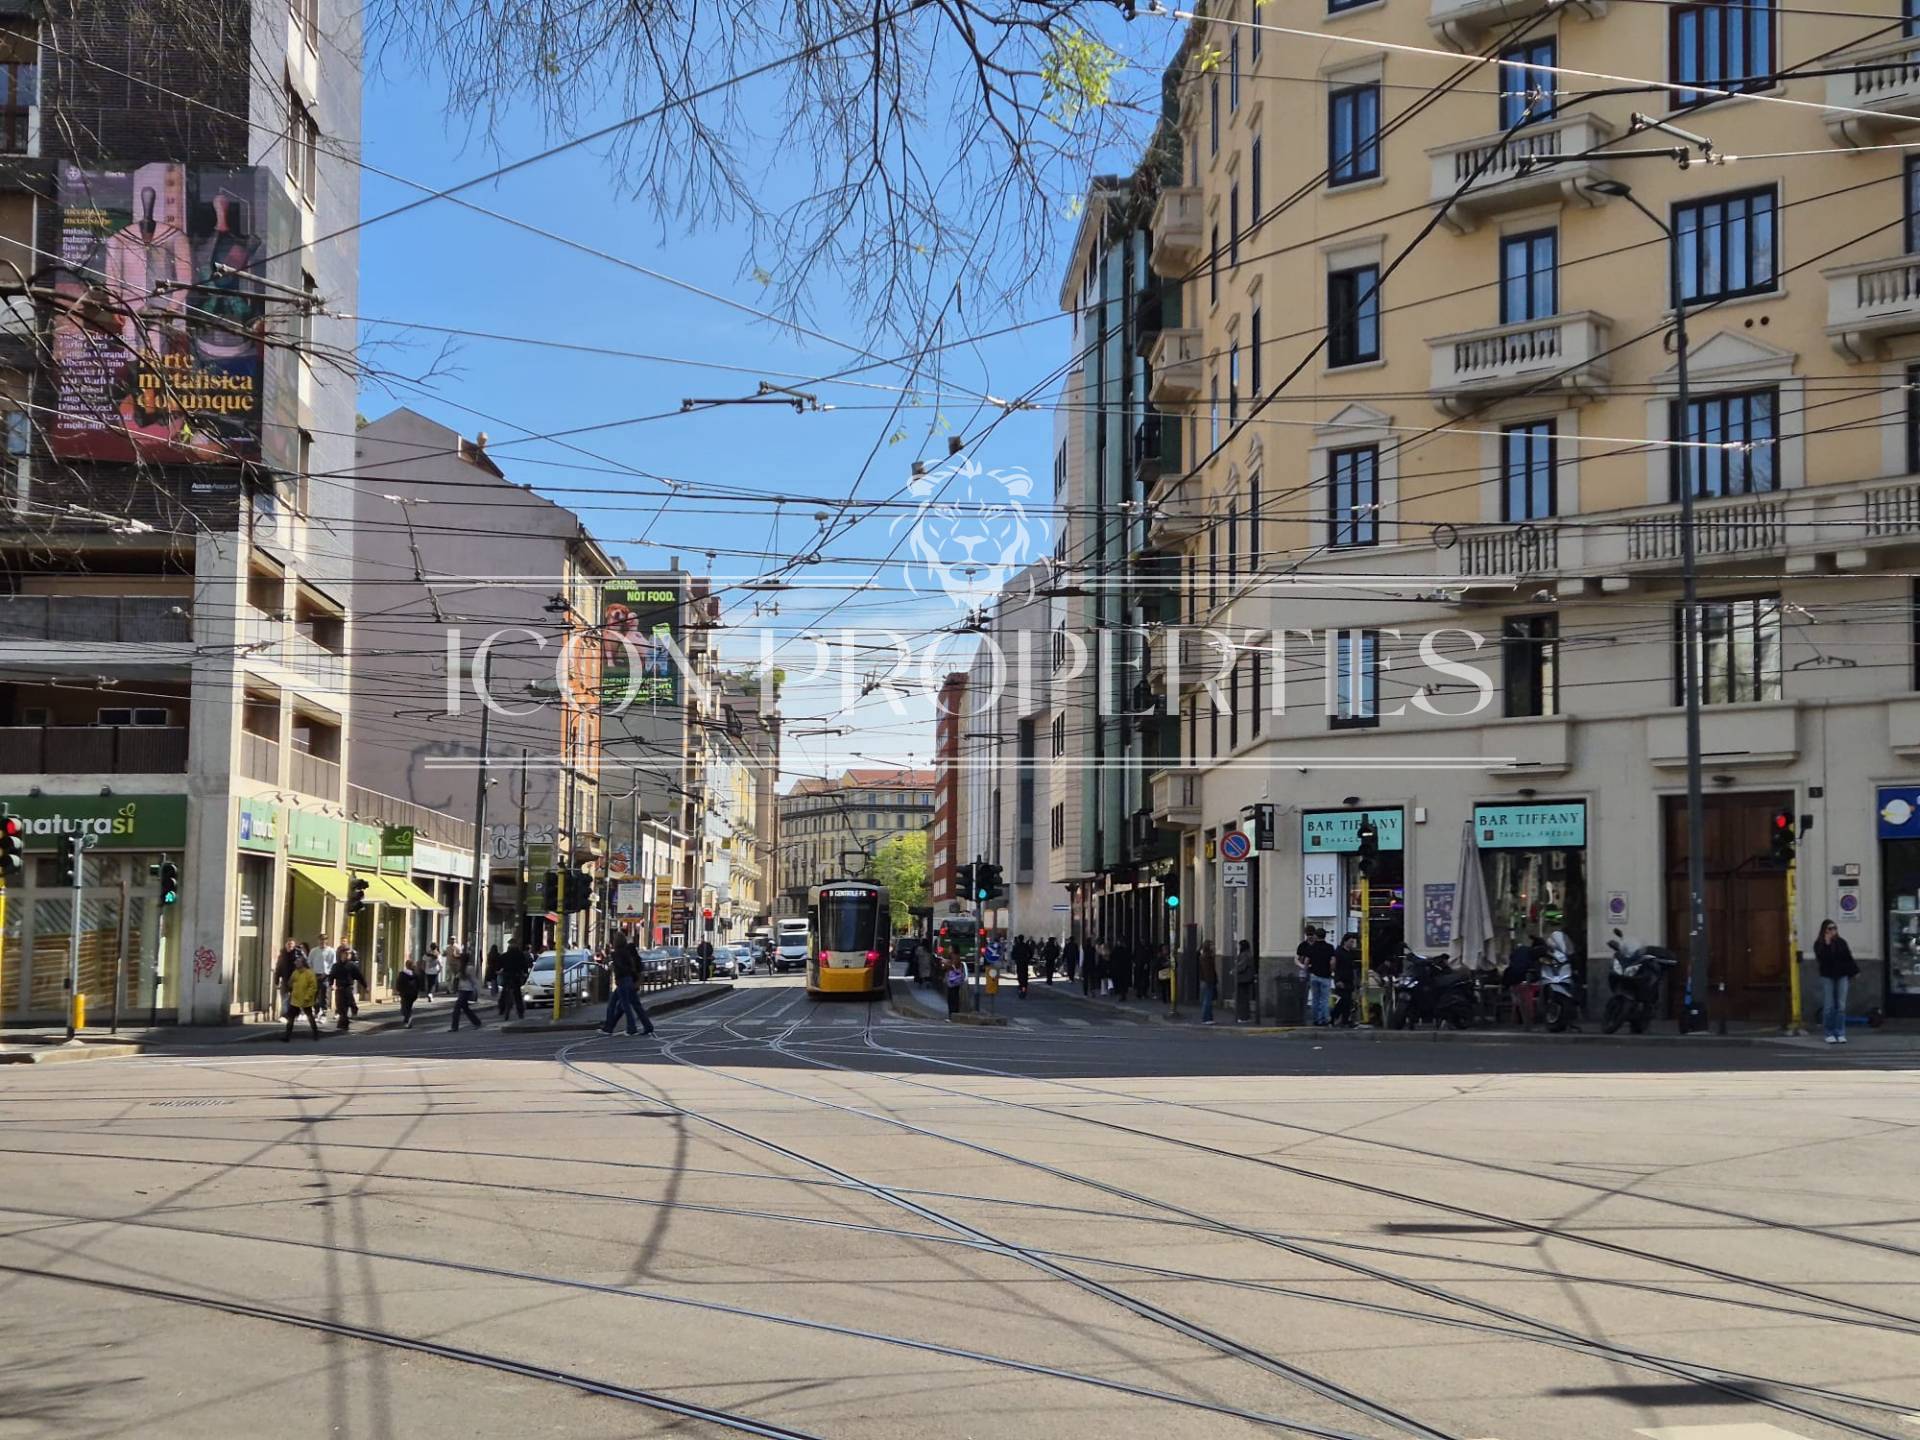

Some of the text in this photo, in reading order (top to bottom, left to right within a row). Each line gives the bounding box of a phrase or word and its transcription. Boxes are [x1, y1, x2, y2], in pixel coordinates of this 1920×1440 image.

[138, 369, 254, 390] mtafisica
[627, 591, 676, 602] NOT FOOD.
[1307, 817, 1398, 832] BAR TIFANY
[1479, 812, 1580, 826] BAR TIFFANY
[1306, 873, 1335, 886] SELF
[1308, 886, 1333, 899] H24
